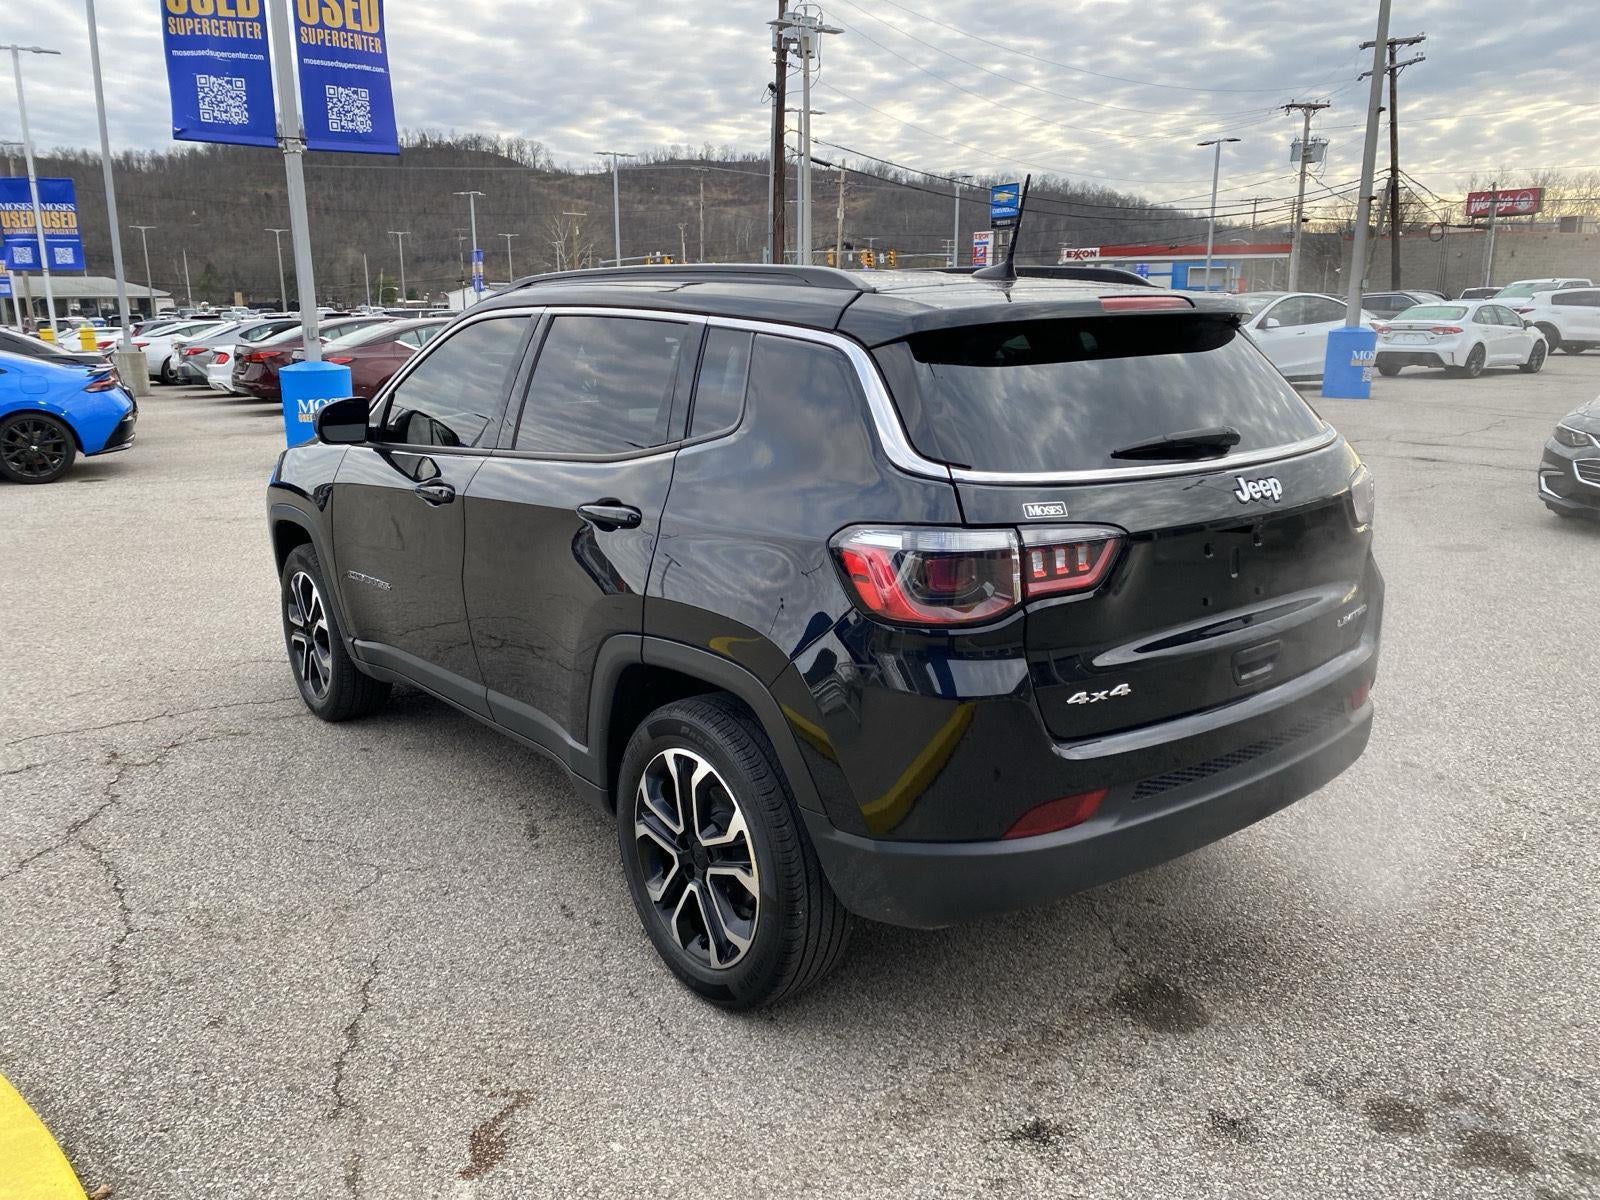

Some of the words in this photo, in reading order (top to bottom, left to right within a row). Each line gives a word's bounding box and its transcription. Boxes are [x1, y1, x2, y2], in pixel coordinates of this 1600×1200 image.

[168, 16, 262, 40] SUPERCENTER
[301, 26, 382, 54] SUPERCENTER
[172, 48, 264, 61] mosesusedsupercenter.com
[41, 203, 75, 211] MOSES
[0, 211, 36, 228] USED
[41, 211, 77, 229] USED
[1066, 249, 1097, 260] EXXON
[1235, 476, 1282, 502] Jeep
[1027, 505, 1064, 517] MOSES
[1066, 683, 1132, 705] 4x4
